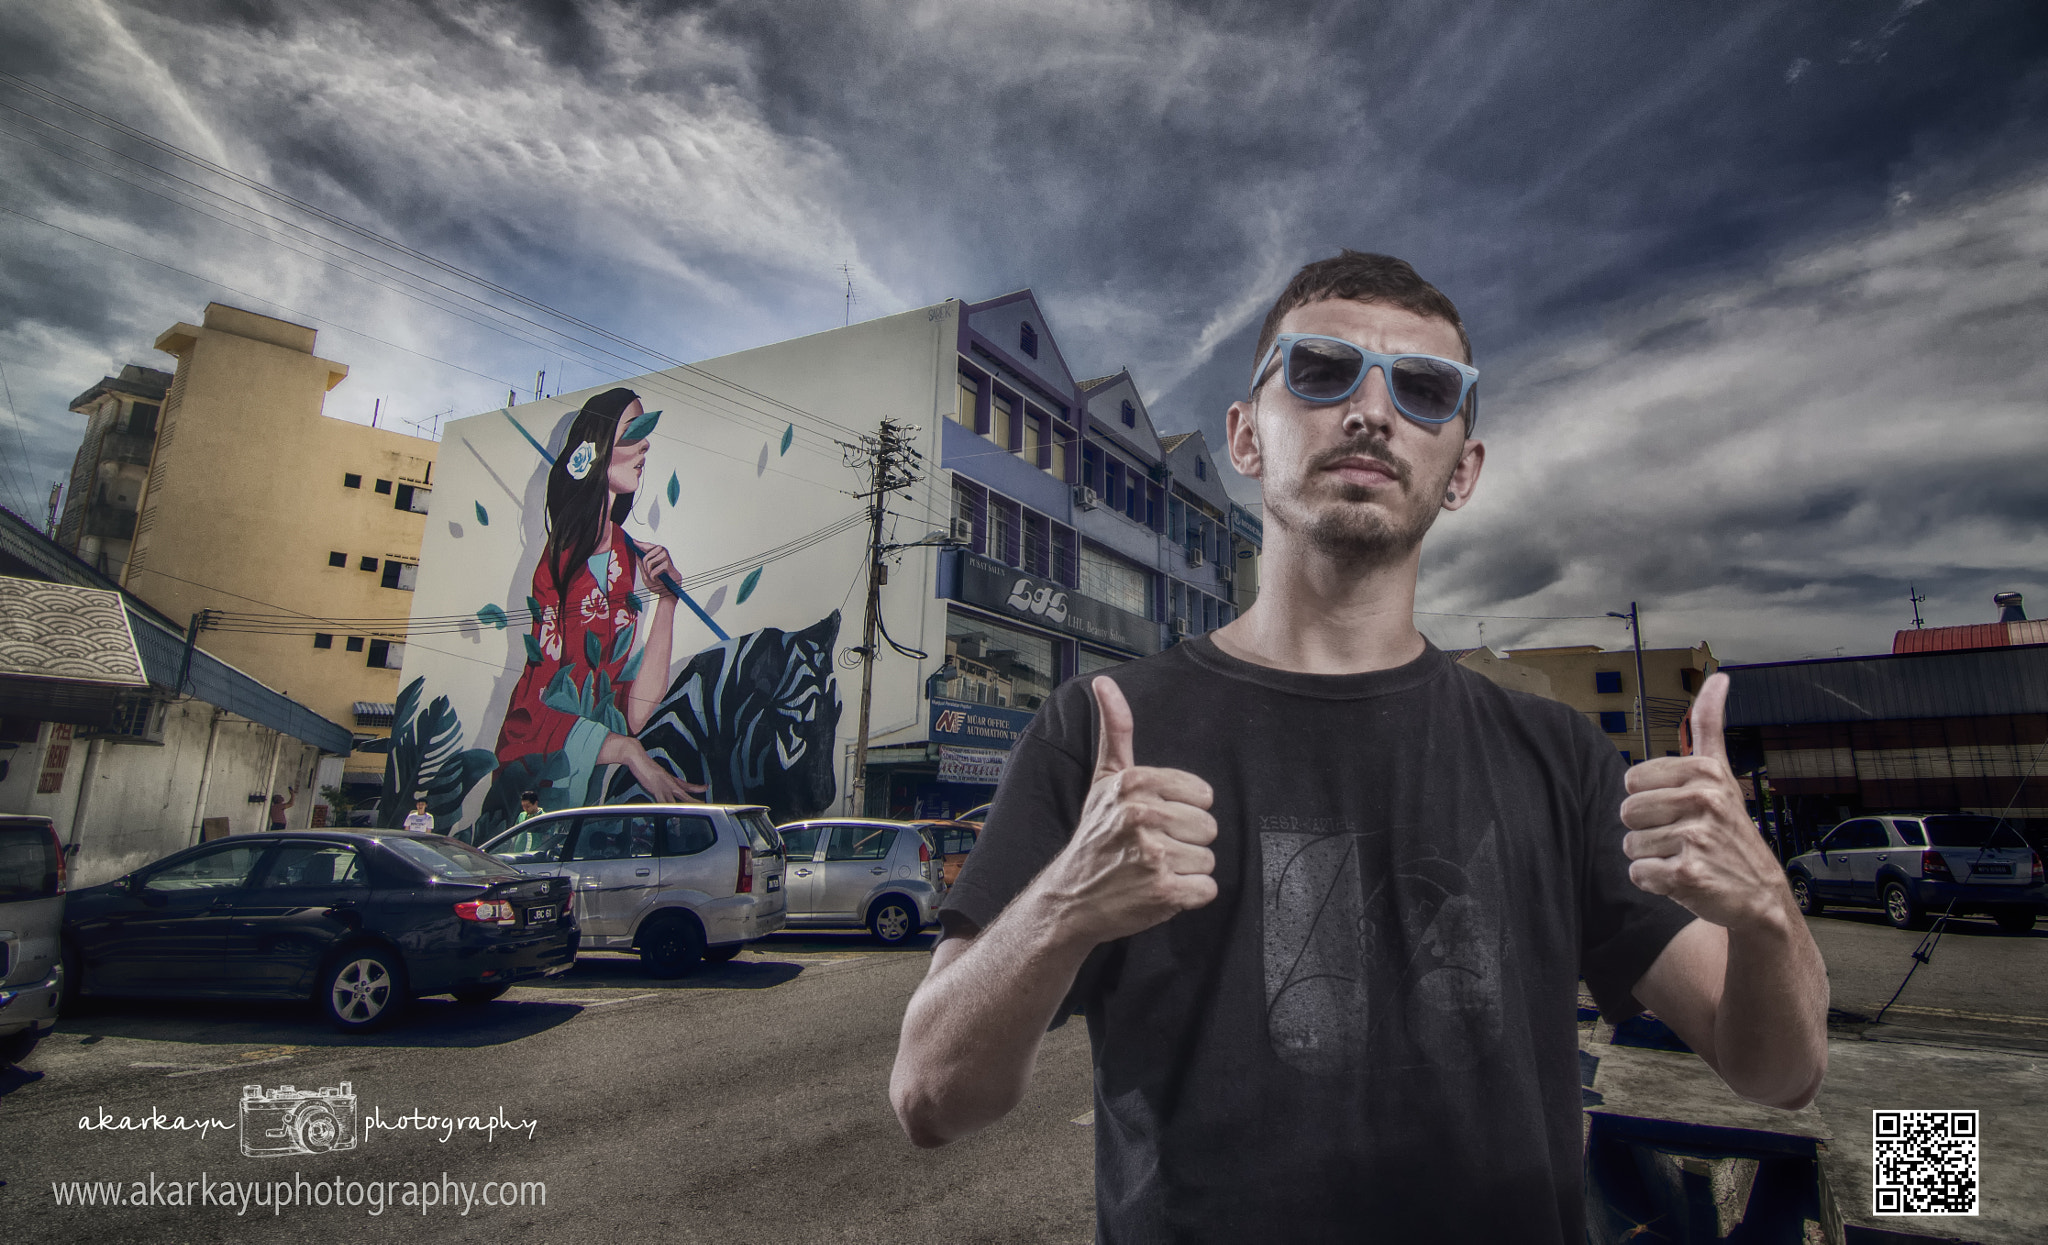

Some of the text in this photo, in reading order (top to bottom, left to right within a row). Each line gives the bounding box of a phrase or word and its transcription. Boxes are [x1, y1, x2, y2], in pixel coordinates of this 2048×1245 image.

[1067, 614, 1084, 632] LHL
[1087, 621, 1109, 638] Beauty
[987, 717, 1010, 729] OFFICE
[967, 726, 1020, 740] AUTOMATION TR
